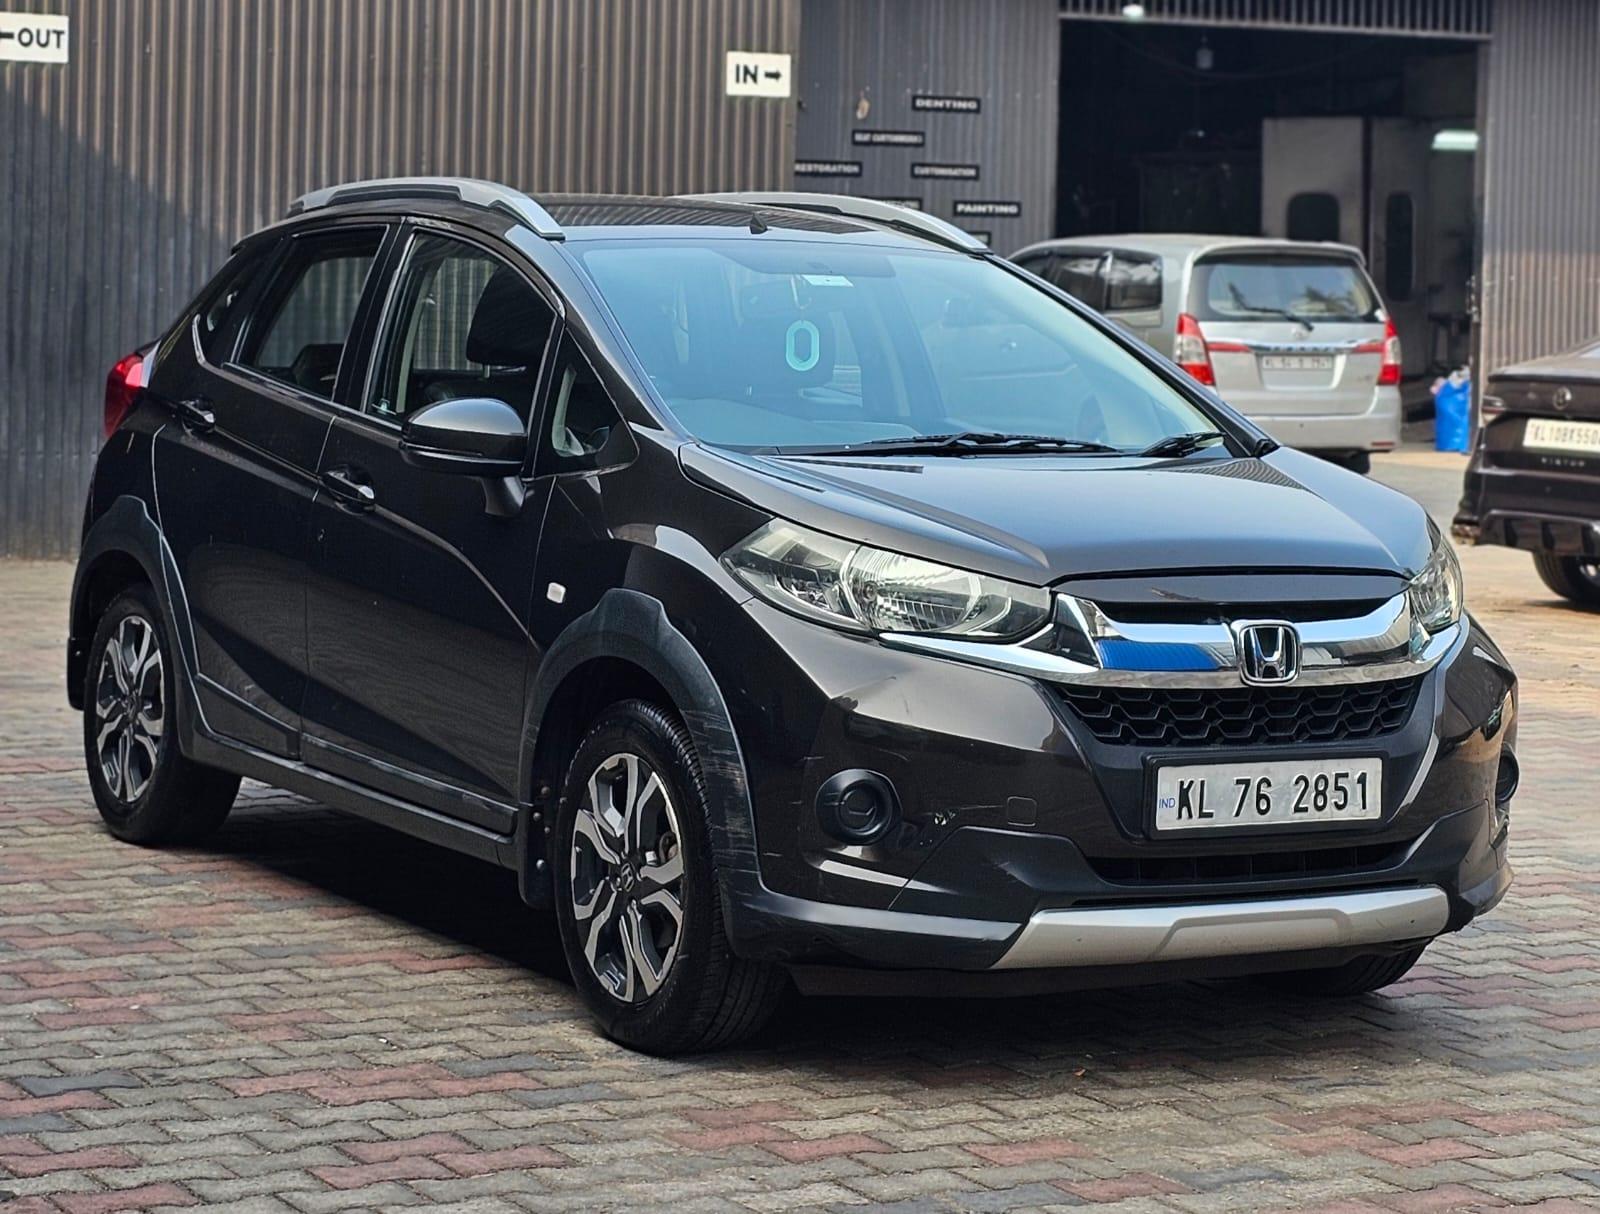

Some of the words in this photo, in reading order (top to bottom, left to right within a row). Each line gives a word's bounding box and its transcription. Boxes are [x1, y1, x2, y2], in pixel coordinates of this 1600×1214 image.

[18, 28, 65, 49] OUT
[735, 64, 758, 84] IN
[916, 98, 978, 110] DENTING
[795, 163, 860, 174] RESTORATION
[956, 204, 1019, 214] PAINTING
[1158, 797, 1175, 809] IND
[1178, 779, 1214, 820] KL
[1233, 777, 1272, 818] 76
[1292, 772, 1368, 814] 2851
